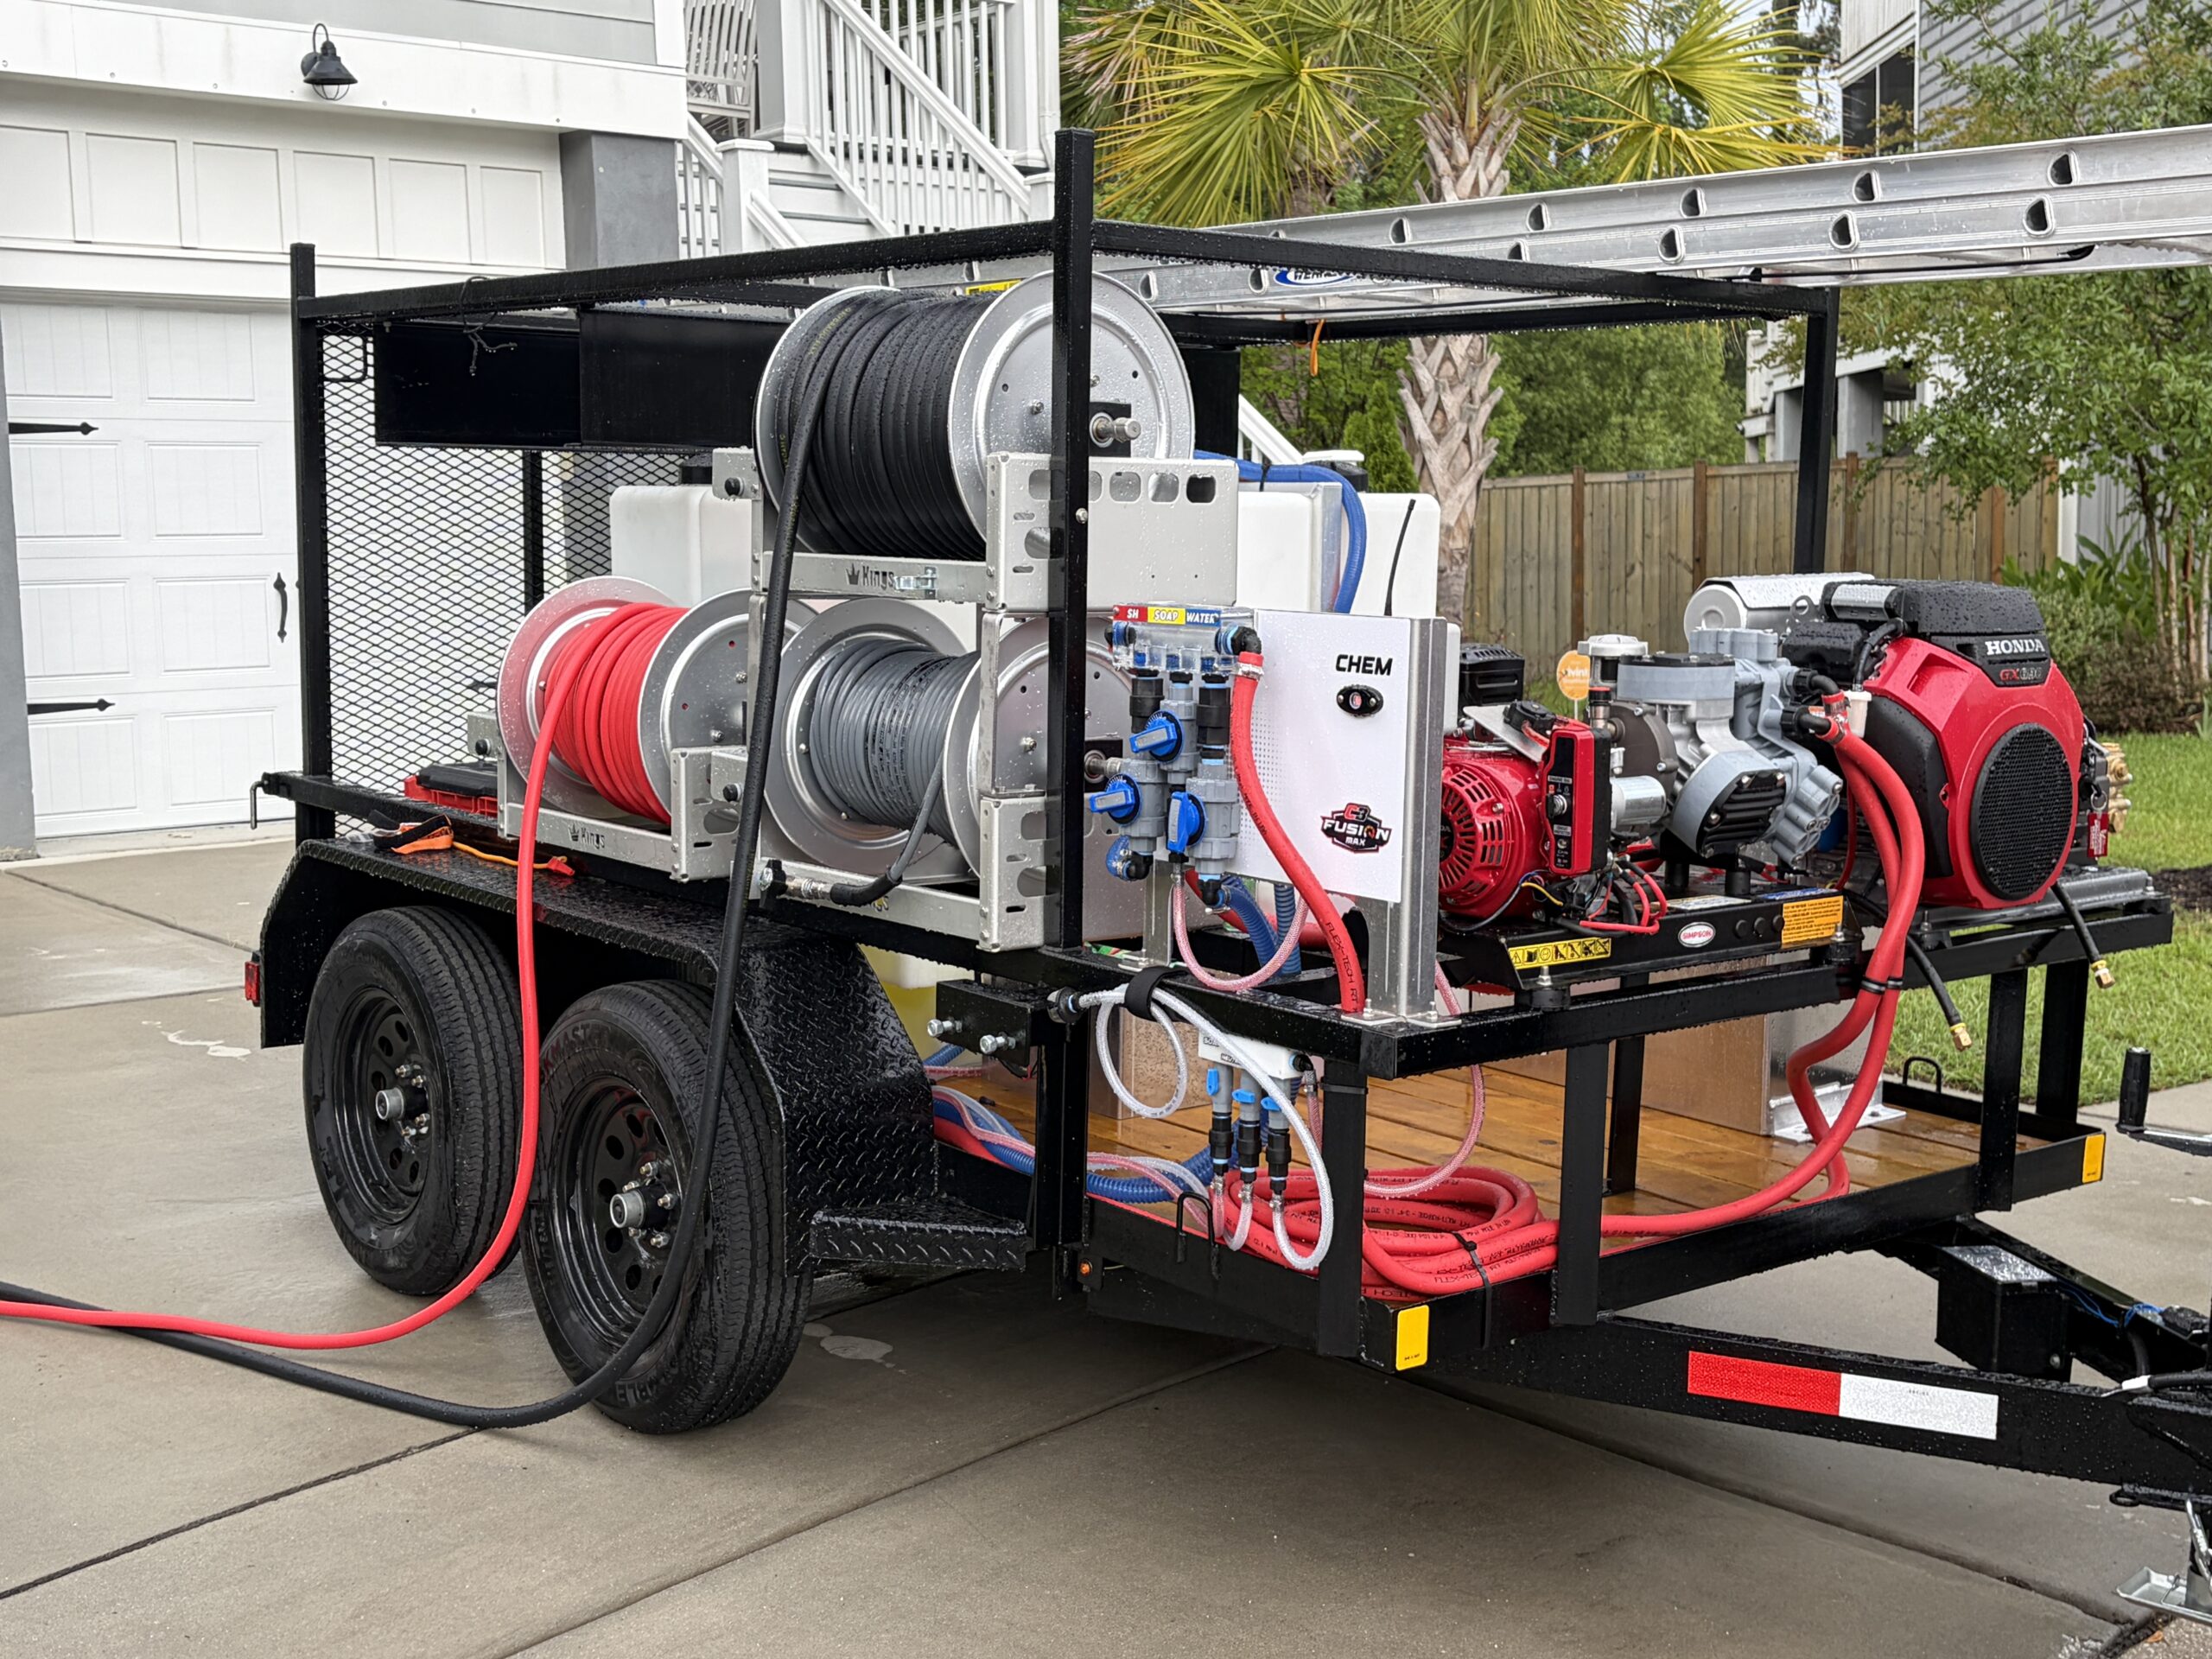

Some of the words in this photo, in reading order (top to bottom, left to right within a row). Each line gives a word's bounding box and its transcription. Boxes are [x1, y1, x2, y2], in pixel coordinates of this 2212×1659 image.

[862, 565, 894, 591] Kings
[1127, 608, 1139, 620] SH
[1154, 610, 1179, 622] SOAP
[1187, 612, 1217, 624] WATER
[1985, 639, 2045, 656] HONDA
[1335, 654, 1393, 677] CHEM
[1323, 817, 1389, 842] FUSION
[1344, 836, 1366, 846] MAX
[1325, 921, 1356, 984] FLEX-TECH
